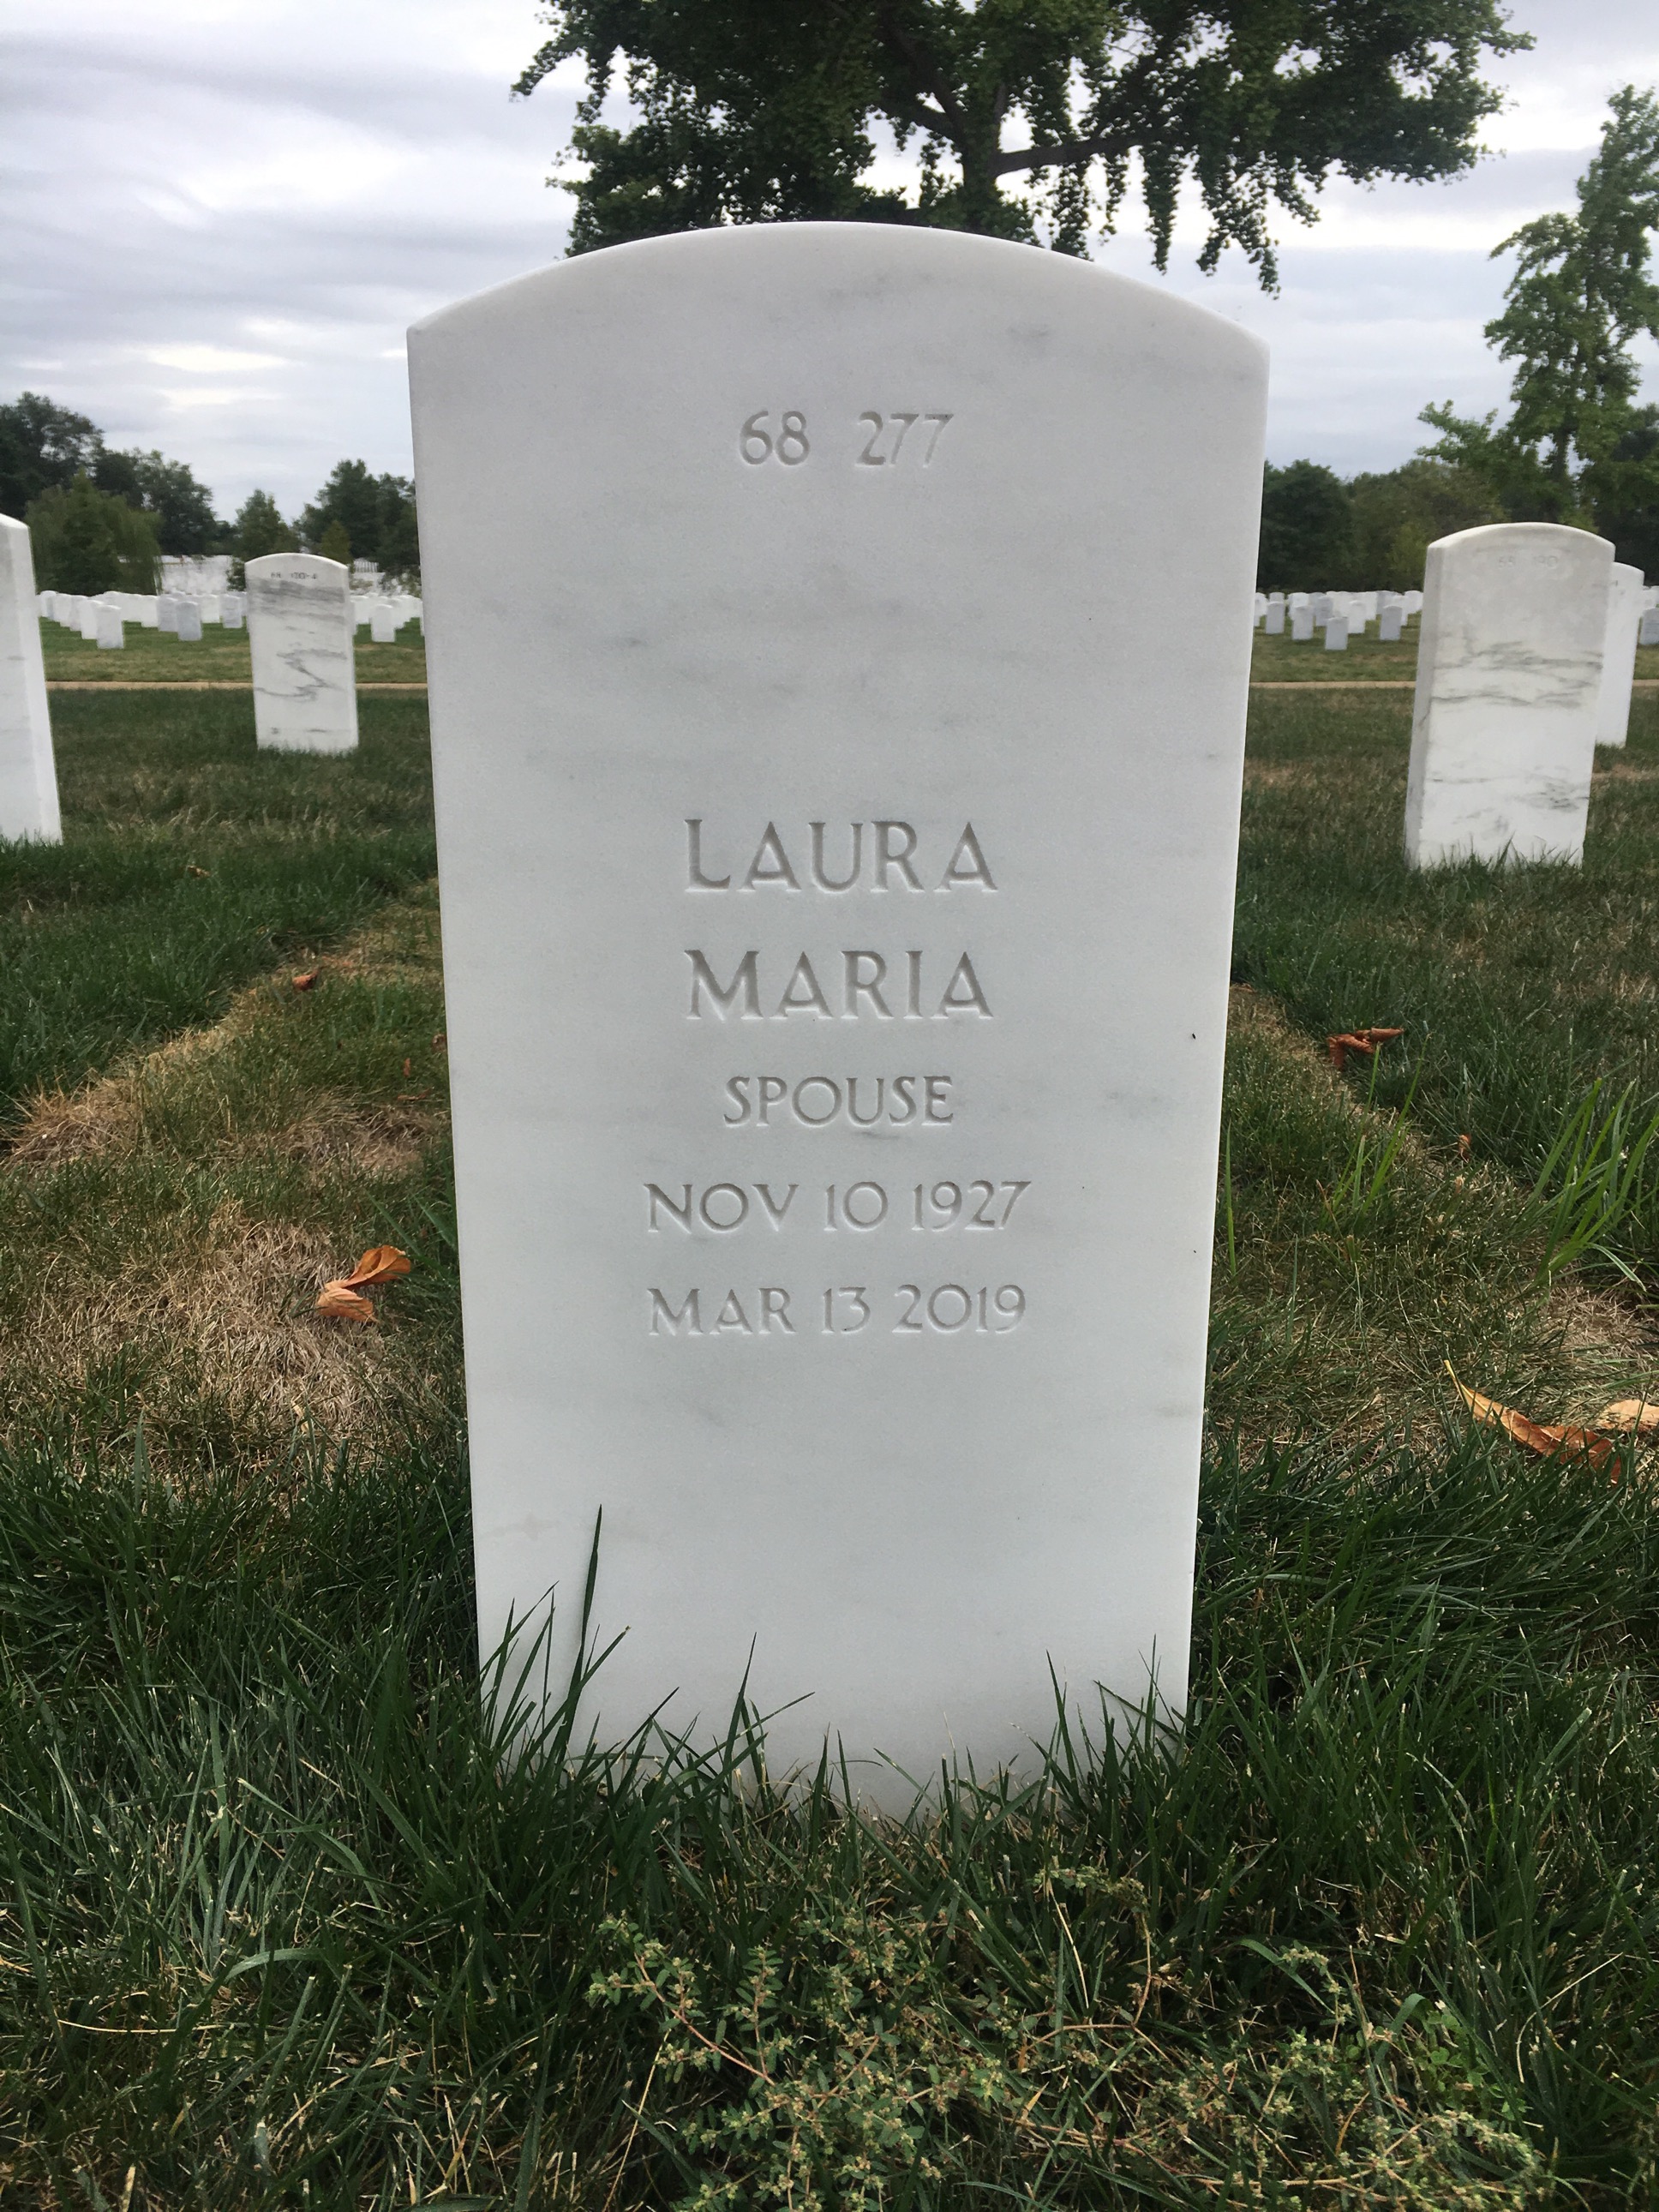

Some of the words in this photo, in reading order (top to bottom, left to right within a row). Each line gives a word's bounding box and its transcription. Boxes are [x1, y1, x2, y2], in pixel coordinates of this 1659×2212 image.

[740, 411, 811, 465] 68
[856, 411, 955, 467] 277
[684, 818, 998, 893] LAURA
[683, 949, 994, 1022] MARIA
[722, 1076, 954, 1127] SPOUSE
[644, 1183, 800, 1233] NOV
[824, 1181, 889, 1232] 10
[911, 1180, 1032, 1232] 1927
[647, 1287, 796, 1336] MAR
[821, 1286, 871, 1334] 13
[891, 1284, 1027, 1334] 2019
